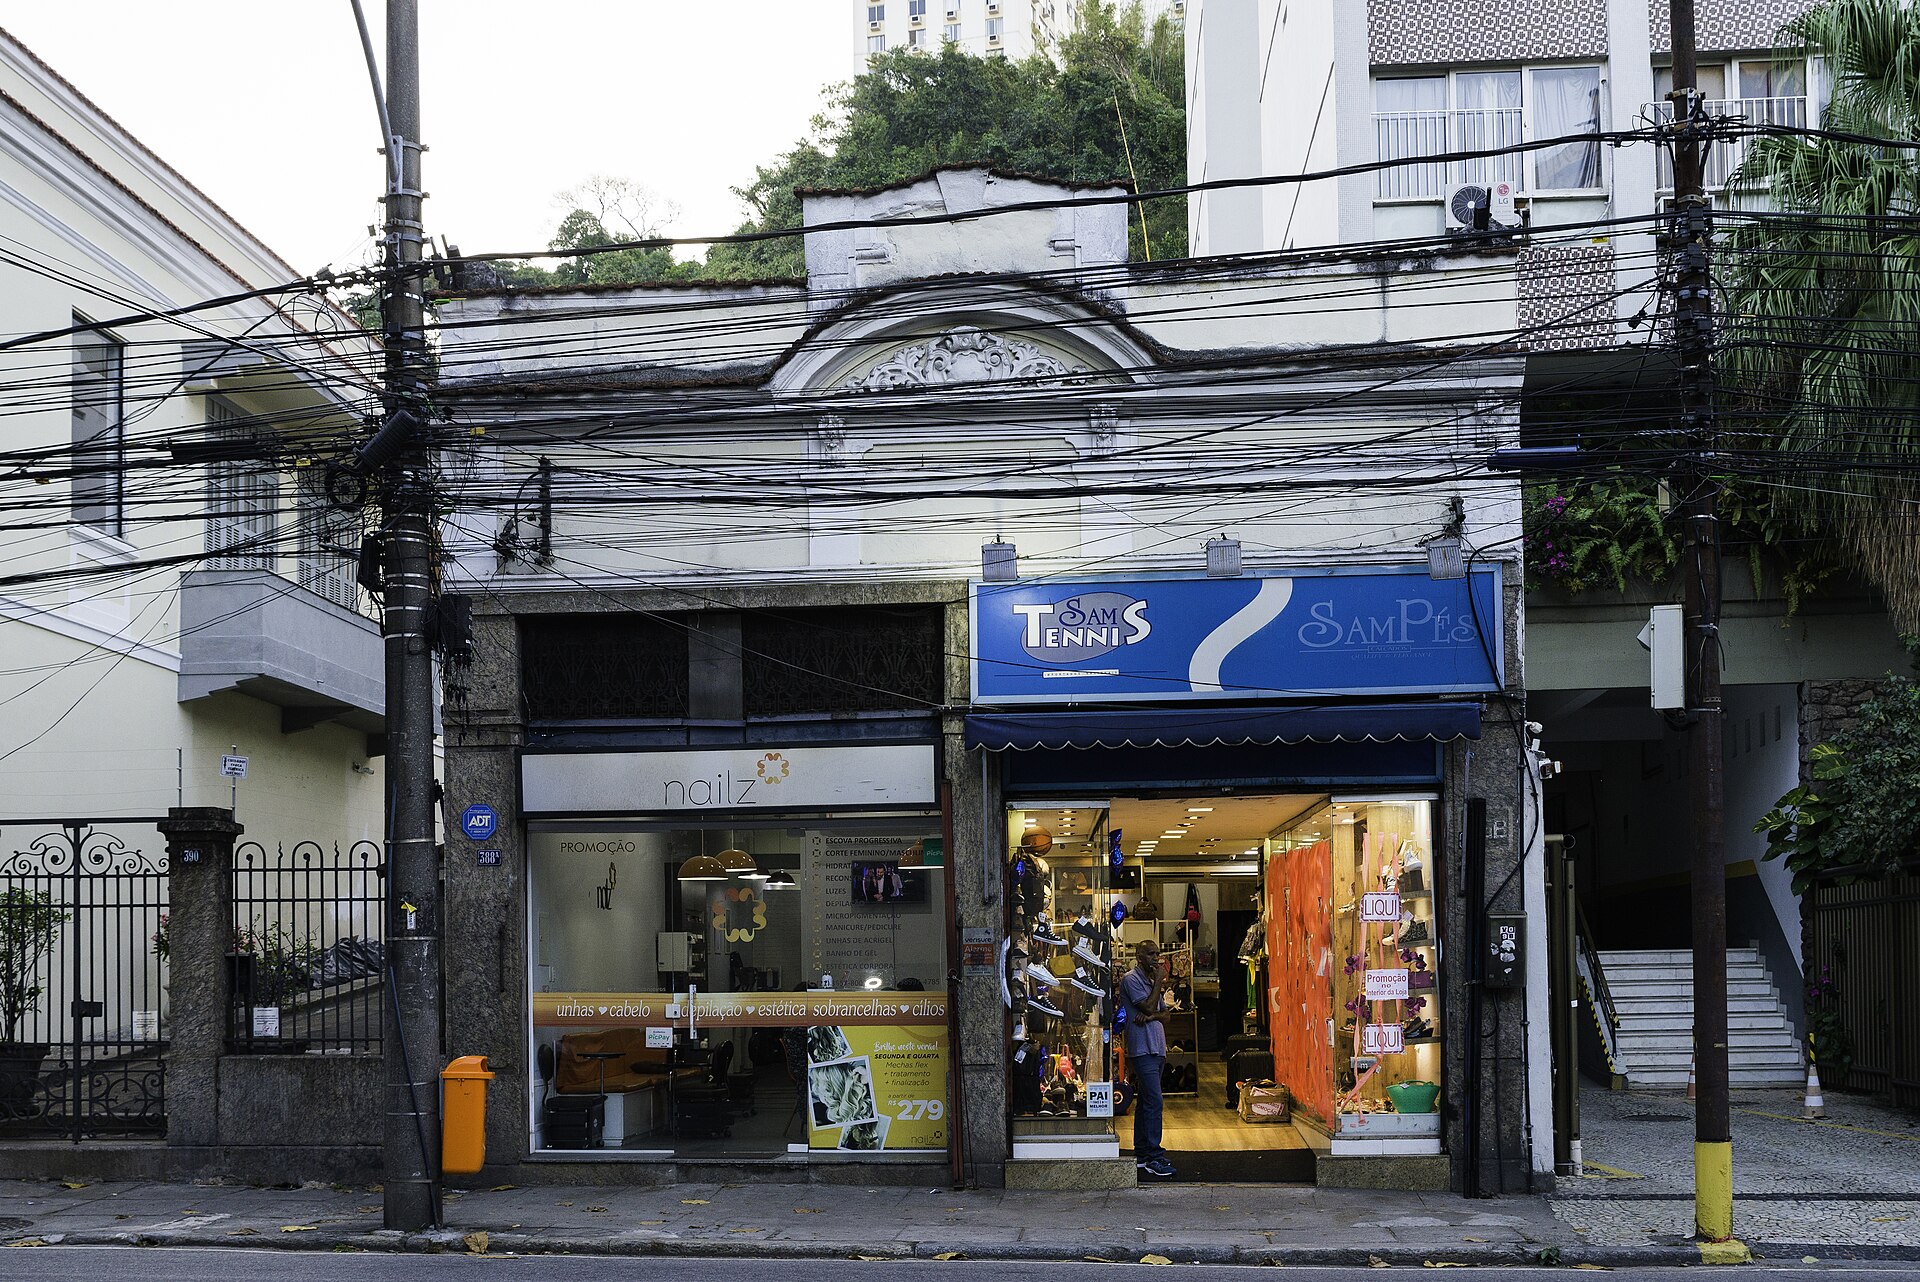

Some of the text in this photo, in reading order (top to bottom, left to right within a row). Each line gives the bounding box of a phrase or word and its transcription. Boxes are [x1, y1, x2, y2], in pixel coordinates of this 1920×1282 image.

[1498, 197, 1509, 205] LG
[663, 769, 757, 806] nailz
[468, 815, 491, 827] ADT
[825, 837, 903, 845] ESCOVA PROGRESSIVA
[560, 839, 636, 855] PROMOÇÃO
[183, 850, 199, 862] 390
[825, 849, 848, 857] CORTE
[1364, 899, 1397, 917] LIQUI
[825, 911, 902, 921] MICROPIGMENTAÇÃO
[825, 923, 902, 932] MANICURE/PEDICURE
[864, 936, 893, 944] ACRIGEL
[864, 949, 878, 957] GEL
[1367, 973, 1407, 984] Promoção
[1366, 989, 1386, 997] Interior
[1395, 988, 1408, 997] Loja
[556, 1000, 594, 1018] unhas
[609, 1000, 651, 1018] cabelo
[758, 1000, 806, 1017] estética
[812, 998, 897, 1017] sobrancelhas
[912, 999, 945, 1017] cílios
[1366, 1031, 1400, 1049] LIQUI
[891, 1079, 930, 1087] finalização
[1089, 1091, 1108, 1101] PAI
[896, 1099, 944, 1121] 279
[910, 1134, 935, 1144] nailz
